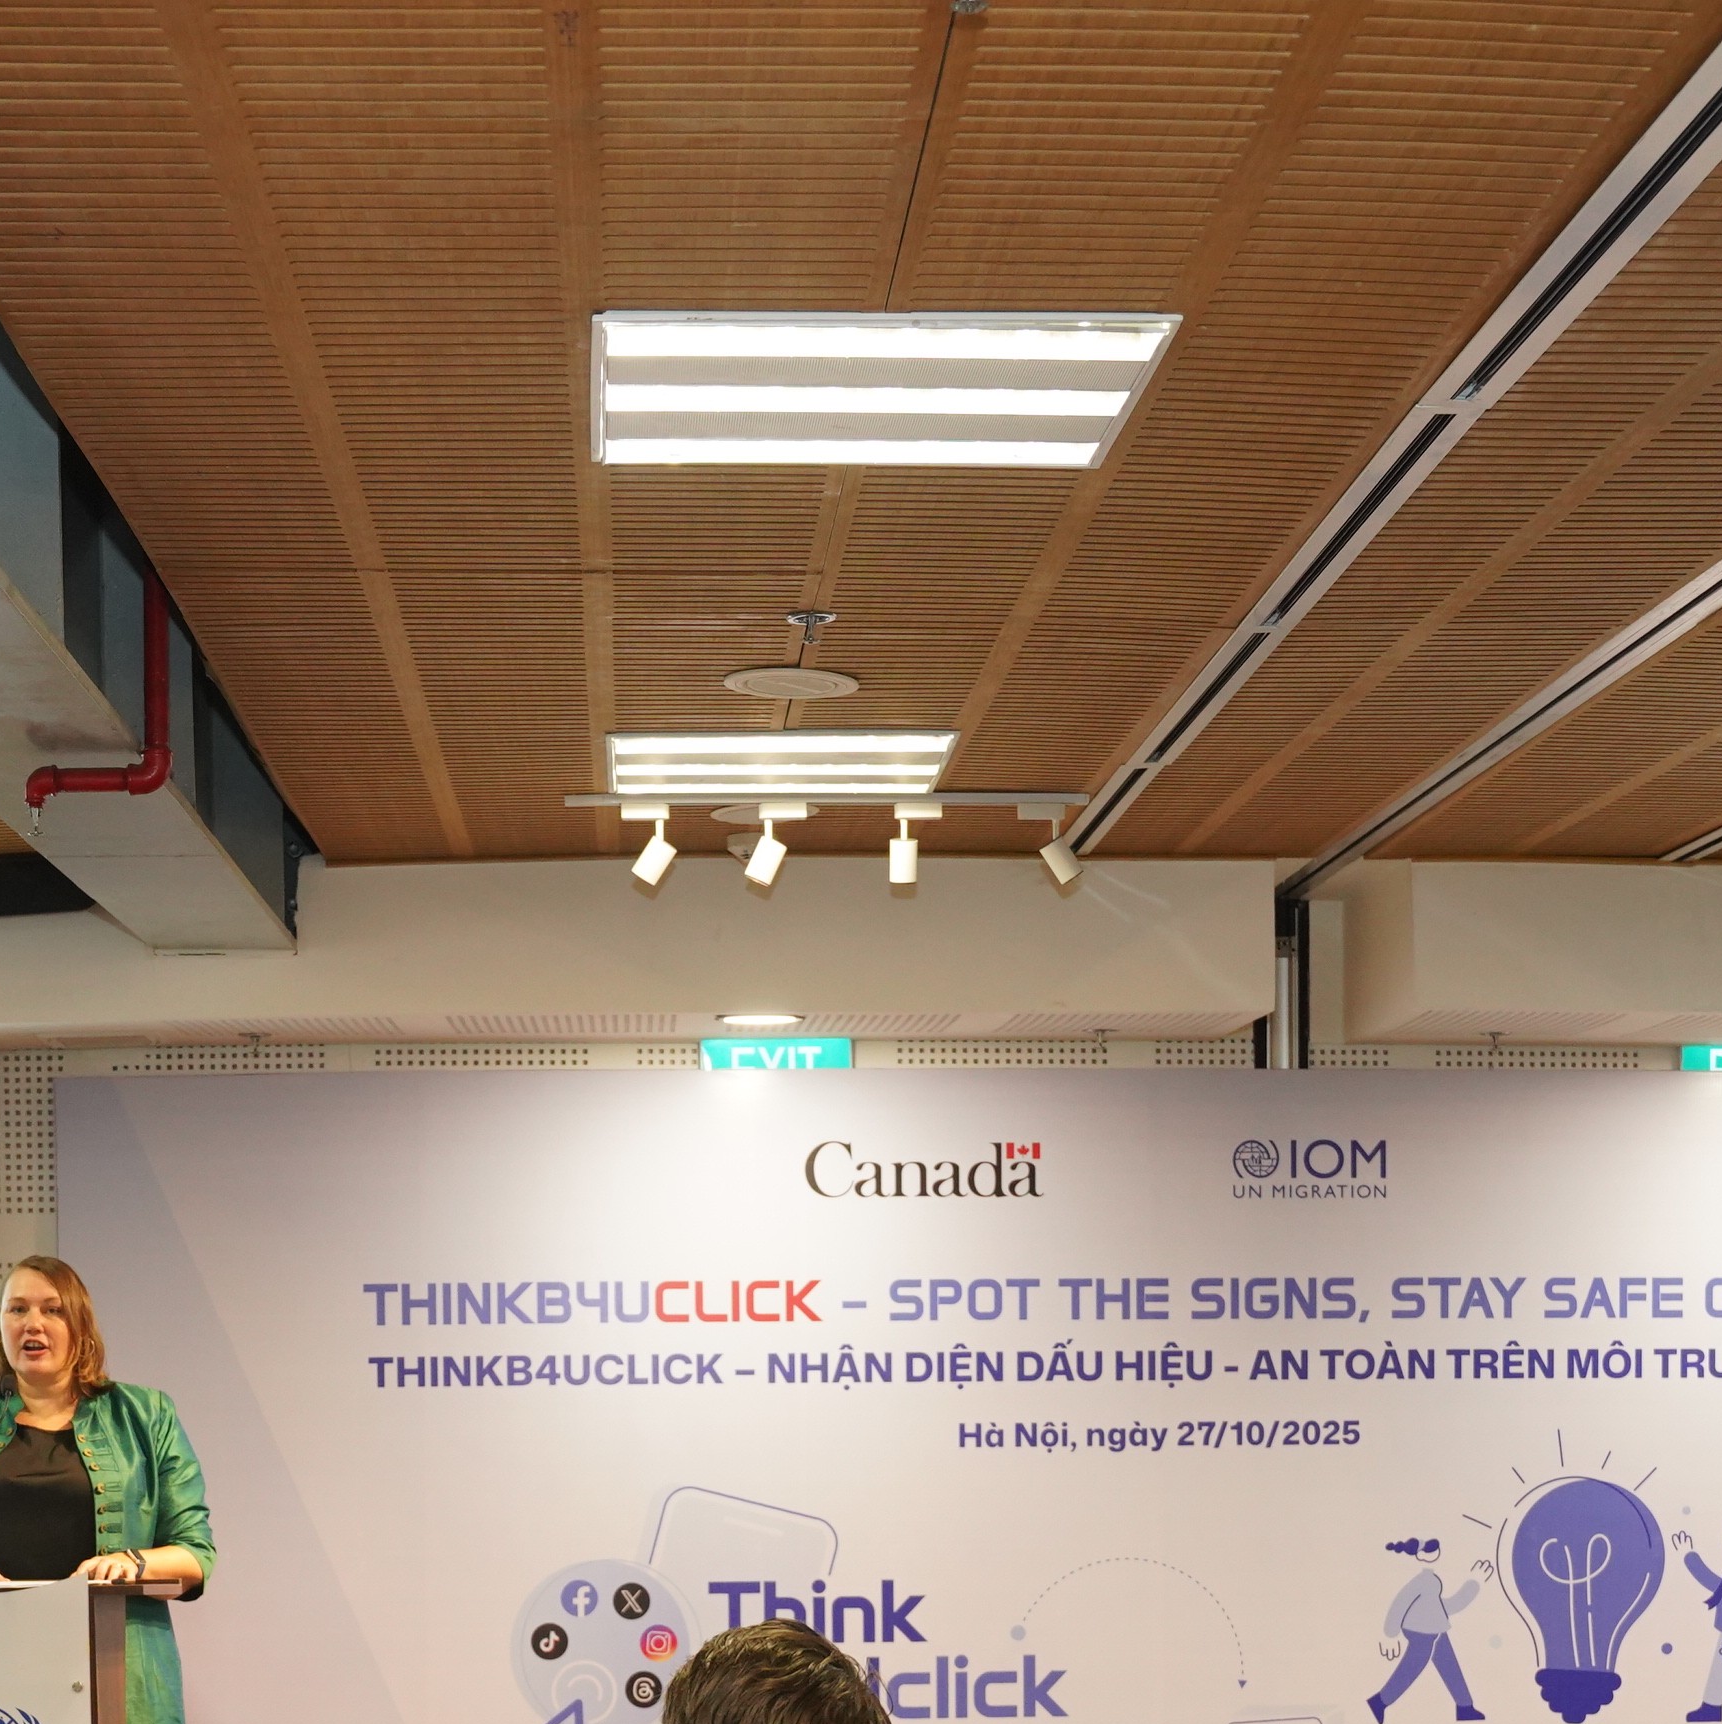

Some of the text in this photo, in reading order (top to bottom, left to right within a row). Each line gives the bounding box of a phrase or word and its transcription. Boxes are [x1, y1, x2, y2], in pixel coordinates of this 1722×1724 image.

[806, 1142, 1043, 1197] Canada
[1291, 1139, 1386, 1178] IOM
[1233, 1184, 1386, 1199] UN MIGRATION
[363, 1280, 823, 1326] THINKB4UCLICK
[890, 1278, 1040, 1321] SPOT
[1059, 1278, 1169, 1320] THE
[1191, 1277, 1369, 1323] SIGNS,
[1392, 1277, 1526, 1319] STAY
[1544, 1277, 1683, 1318] SAFE
[368, 1355, 722, 1388] THINKB4UCLICK
[768, 1344, 892, 1390] NHẬN
[906, 1343, 1003, 1389] DIỆN
[1017, 1339, 1102, 1381] DẤU
[1116, 1342, 1212, 1388] HIỆU
[1250, 1350, 1308, 1380] AN
[1320, 1341, 1435, 1380] TOÀN
[1455, 1341, 1555, 1380] TRÊN
[1567, 1341, 1642, 1378] MÔI
[959, 1420, 1360, 1453] Hà Nội, ngày 27/10/2025
[708, 1579, 927, 1642] Think
[867, 1654, 1068, 1719] click
